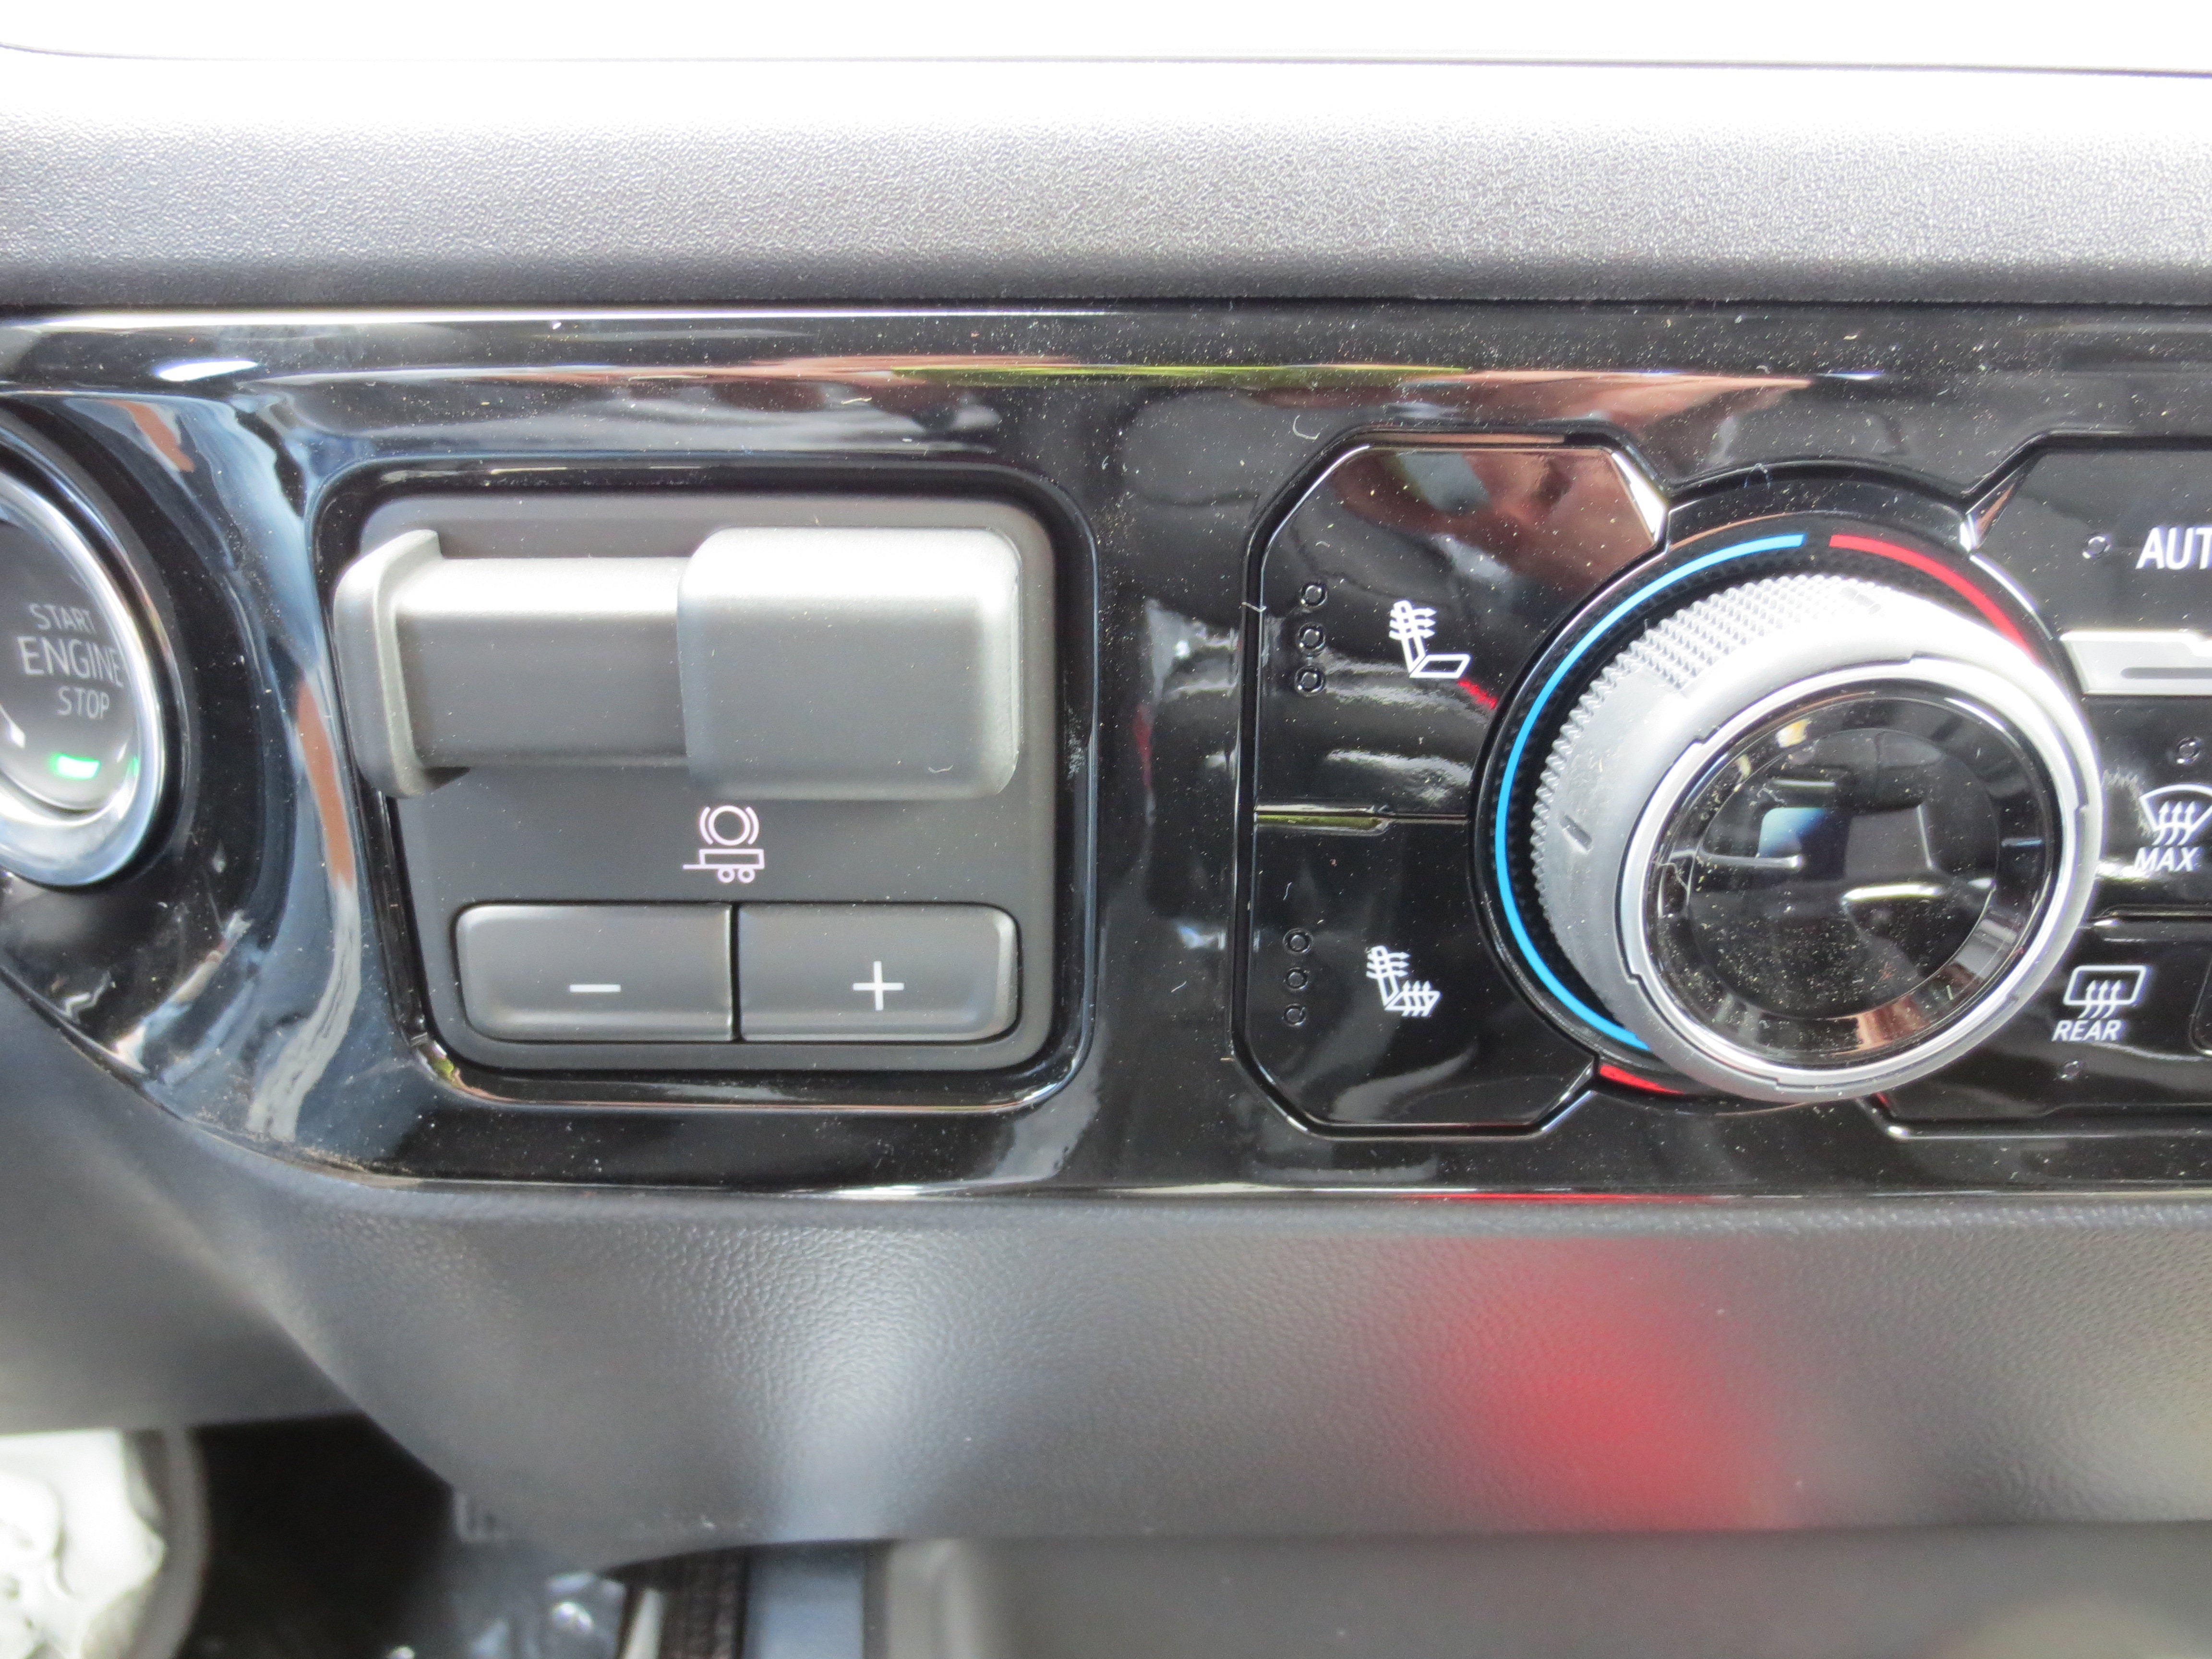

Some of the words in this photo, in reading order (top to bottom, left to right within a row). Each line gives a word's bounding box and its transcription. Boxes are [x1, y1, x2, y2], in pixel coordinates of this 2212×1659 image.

[29, 603, 96, 635] START
[17, 635, 124, 688] ENGINE
[57, 685, 110, 720] STOP
[2135, 846, 2201, 872] MAX
[2051, 1019, 2123, 1042] REAR
